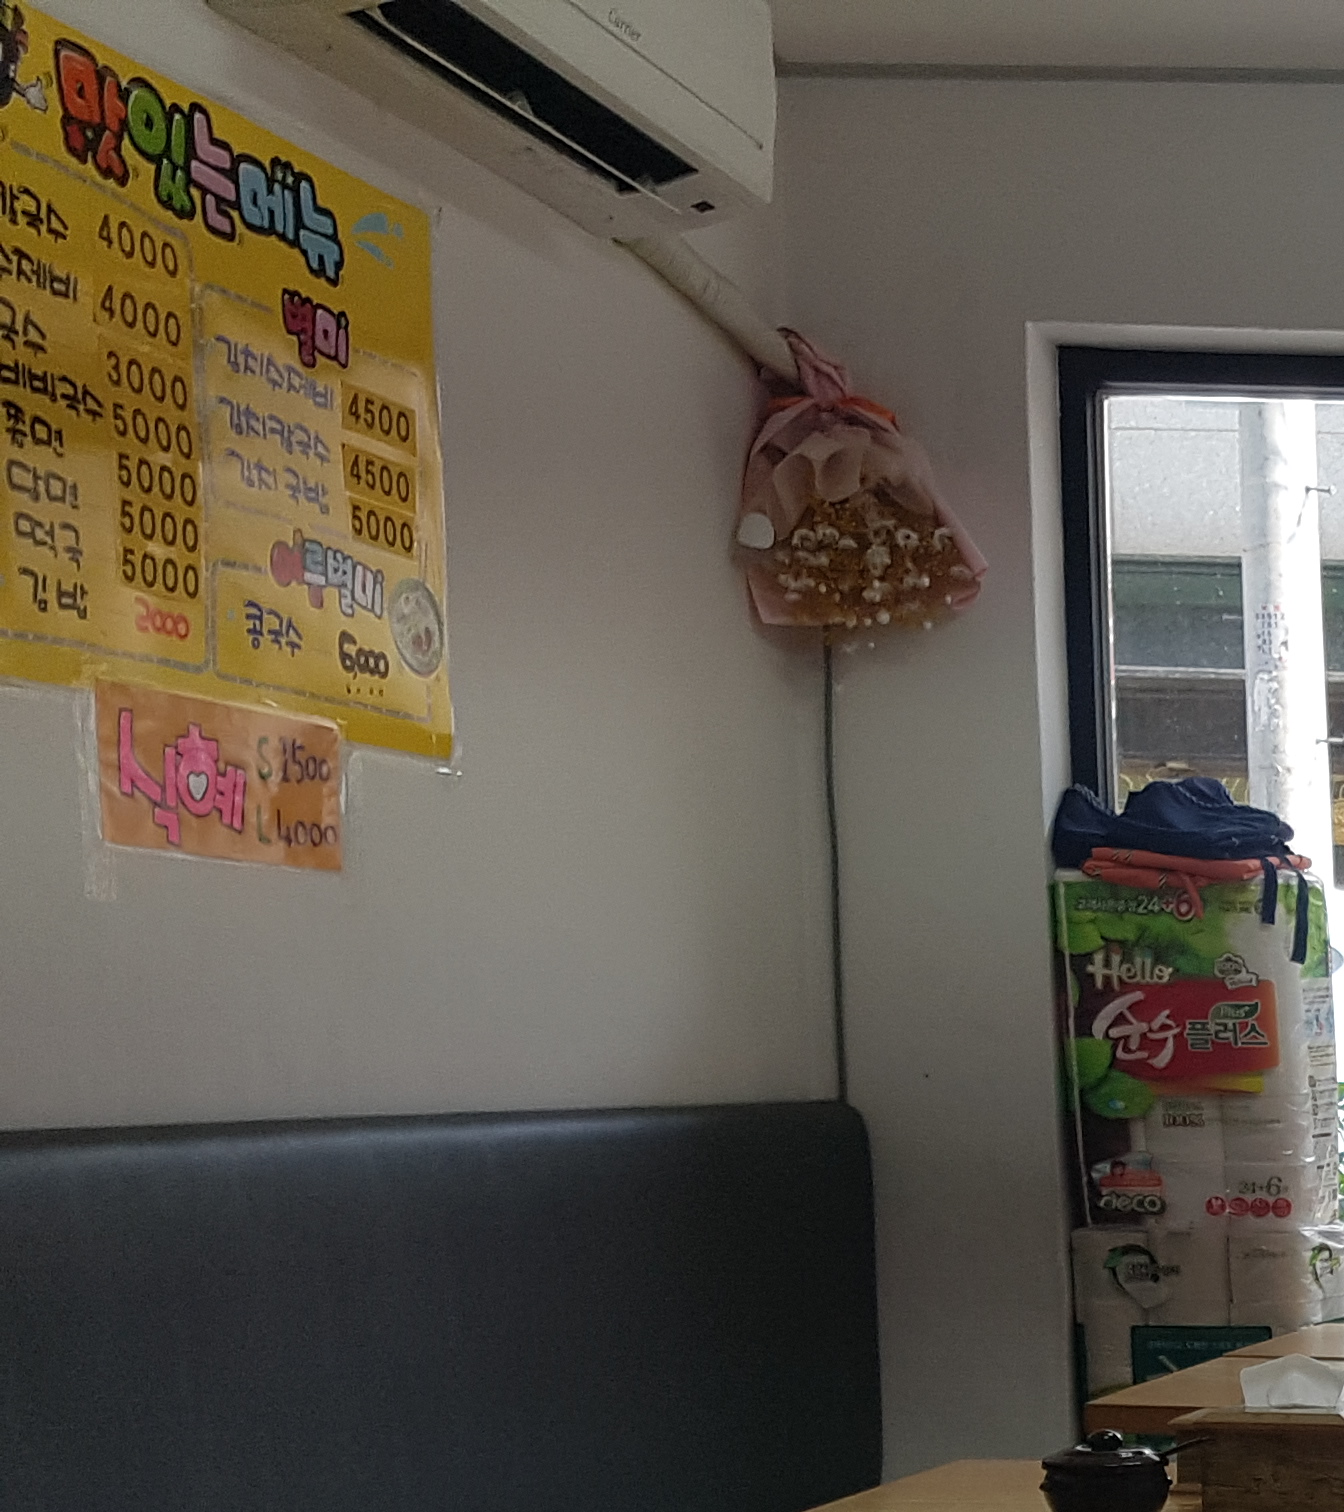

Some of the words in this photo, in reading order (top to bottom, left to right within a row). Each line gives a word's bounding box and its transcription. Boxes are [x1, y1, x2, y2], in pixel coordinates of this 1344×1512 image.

[98, 213, 178, 279] 4000
[100, 284, 181, 347] 4000
[106, 350, 188, 411] 3000
[112, 402, 193, 460] 5000
[348, 392, 410, 443] 4500
[117, 452, 197, 507] 5000
[350, 453, 410, 503] 4500
[119, 500, 199, 553] 5000
[350, 503, 414, 553] 5000
[121, 546, 199, 599] 5000
[1086, 948, 1174, 991] Hello
[1185, 1018, 1270, 1052] 플러스
